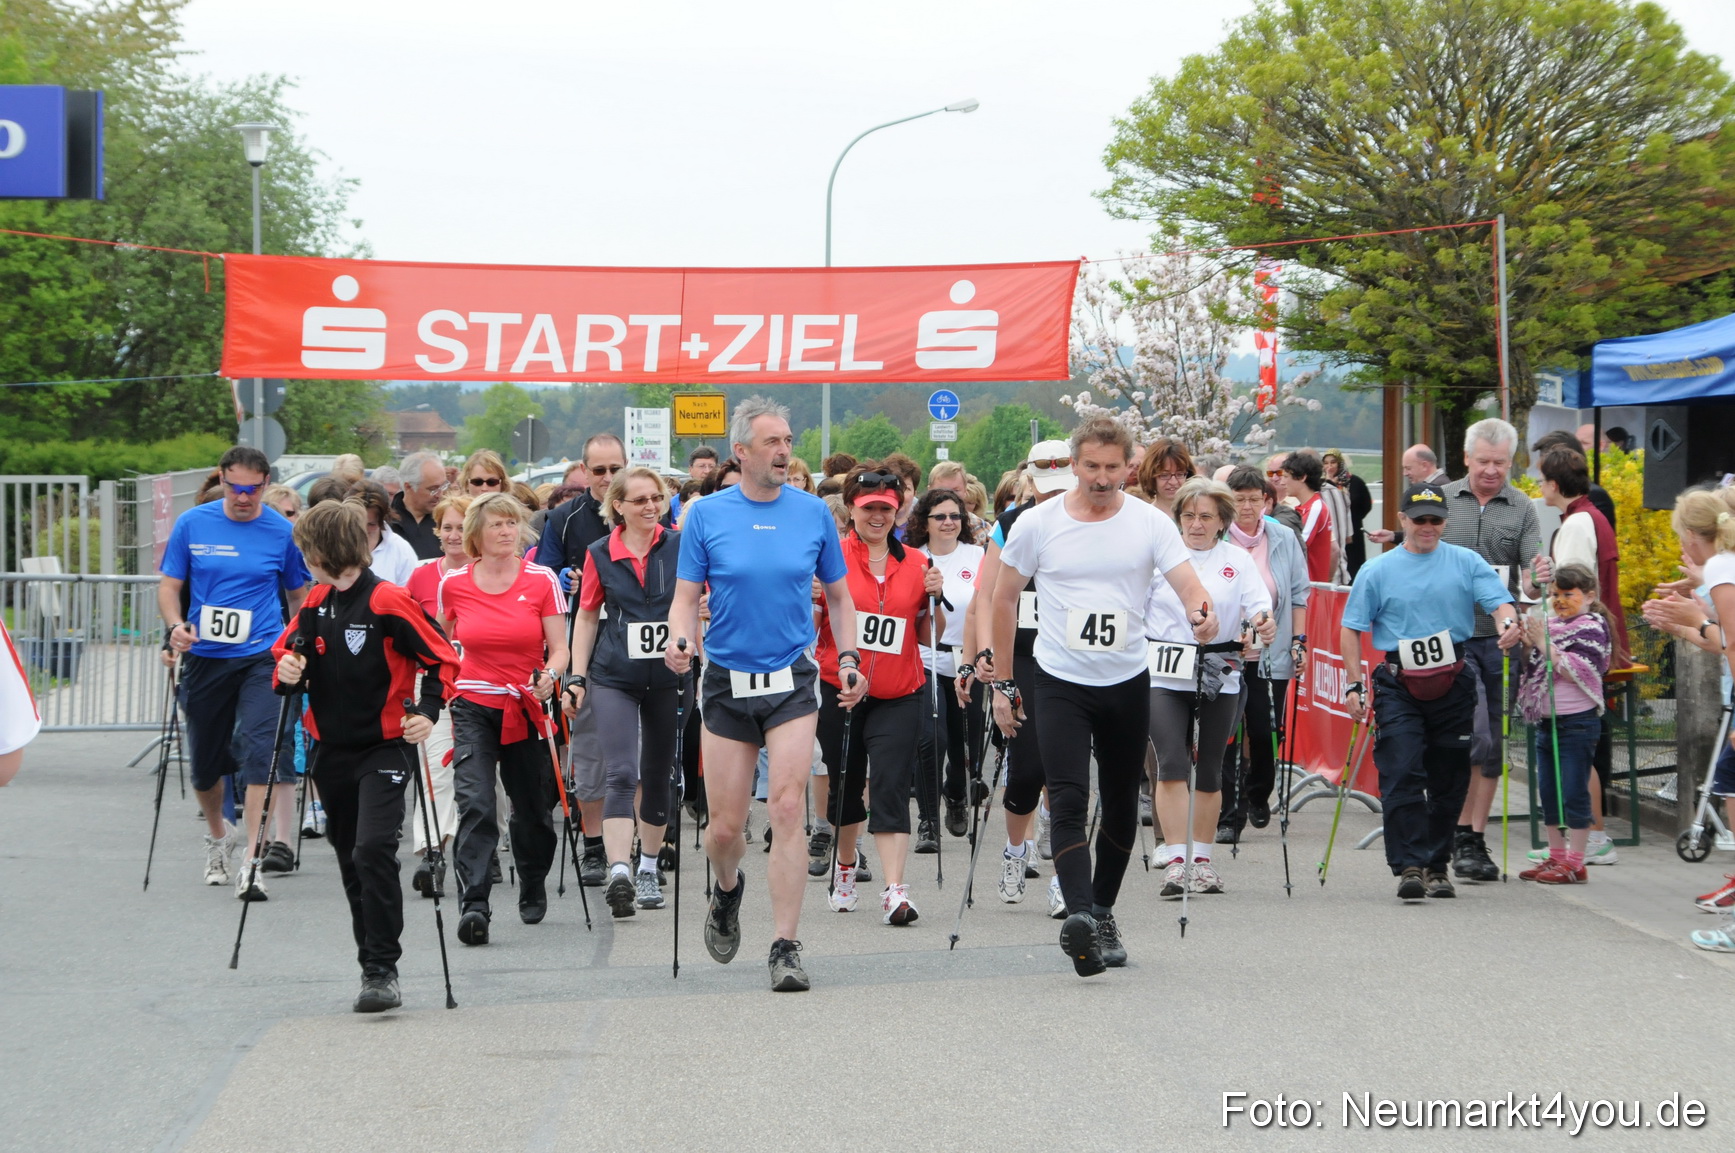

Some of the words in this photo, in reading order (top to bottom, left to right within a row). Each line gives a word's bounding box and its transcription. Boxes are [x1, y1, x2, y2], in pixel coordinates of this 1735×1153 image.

[679, 409, 721, 420] Neumarkt
[210, 609, 241, 639] 50
[640, 623, 669, 653] 92
[862, 614, 897, 647] 90
[1080, 613, 1116, 647] 45
[1156, 645, 1185, 674] 117
[1411, 636, 1444, 667] 89
